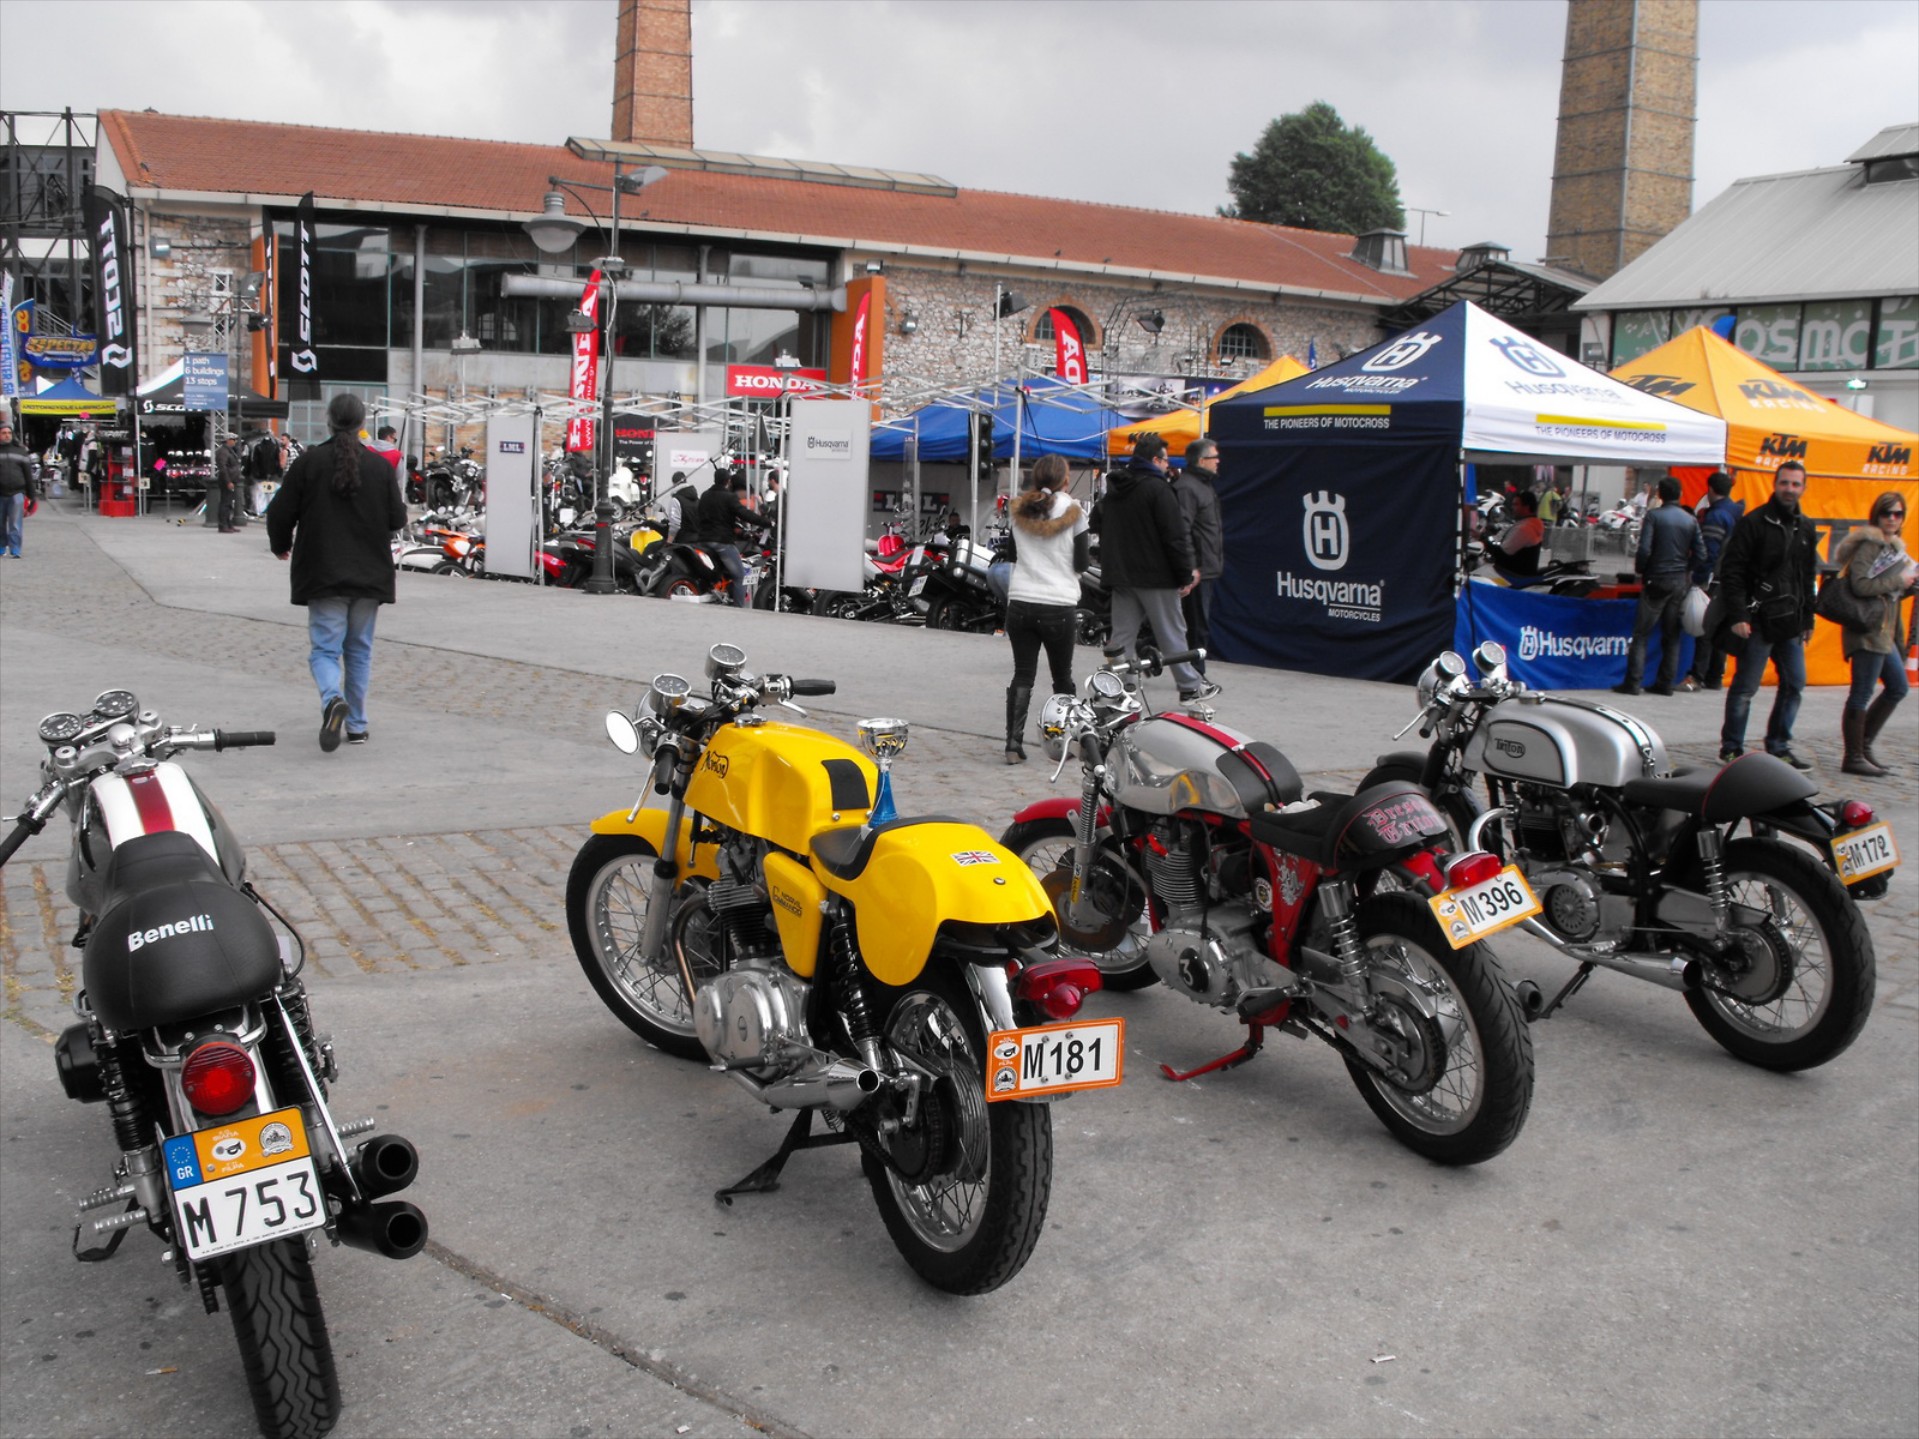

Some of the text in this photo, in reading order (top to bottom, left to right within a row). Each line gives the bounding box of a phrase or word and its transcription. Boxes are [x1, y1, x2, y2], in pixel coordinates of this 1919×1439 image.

[300, 219, 311, 346] SCOTT
[192, 356, 210, 366] path
[185, 366, 225, 377] 6 buildings
[1305, 374, 1419, 391] Husqvarna
[1738, 379, 1816, 403] KTM
[1750, 399, 1827, 414] RACING
[1263, 417, 1390, 429] THE PIONEERS OF MOTOCROSS
[1535, 425, 1667, 444] THE PIONEERS OF MOTOCROSS
[503, 443, 520, 452] LML
[1760, 432, 1808, 458] KTM
[1867, 442, 1911, 465] KTM
[1861, 463, 1909, 475] RACING
[1276, 570, 1382, 607] Husqvarna
[1327, 608, 1381, 622] MOTORCYCLES
[127, 914, 215, 953] Benelli
[176, 1165, 195, 1180] GR
